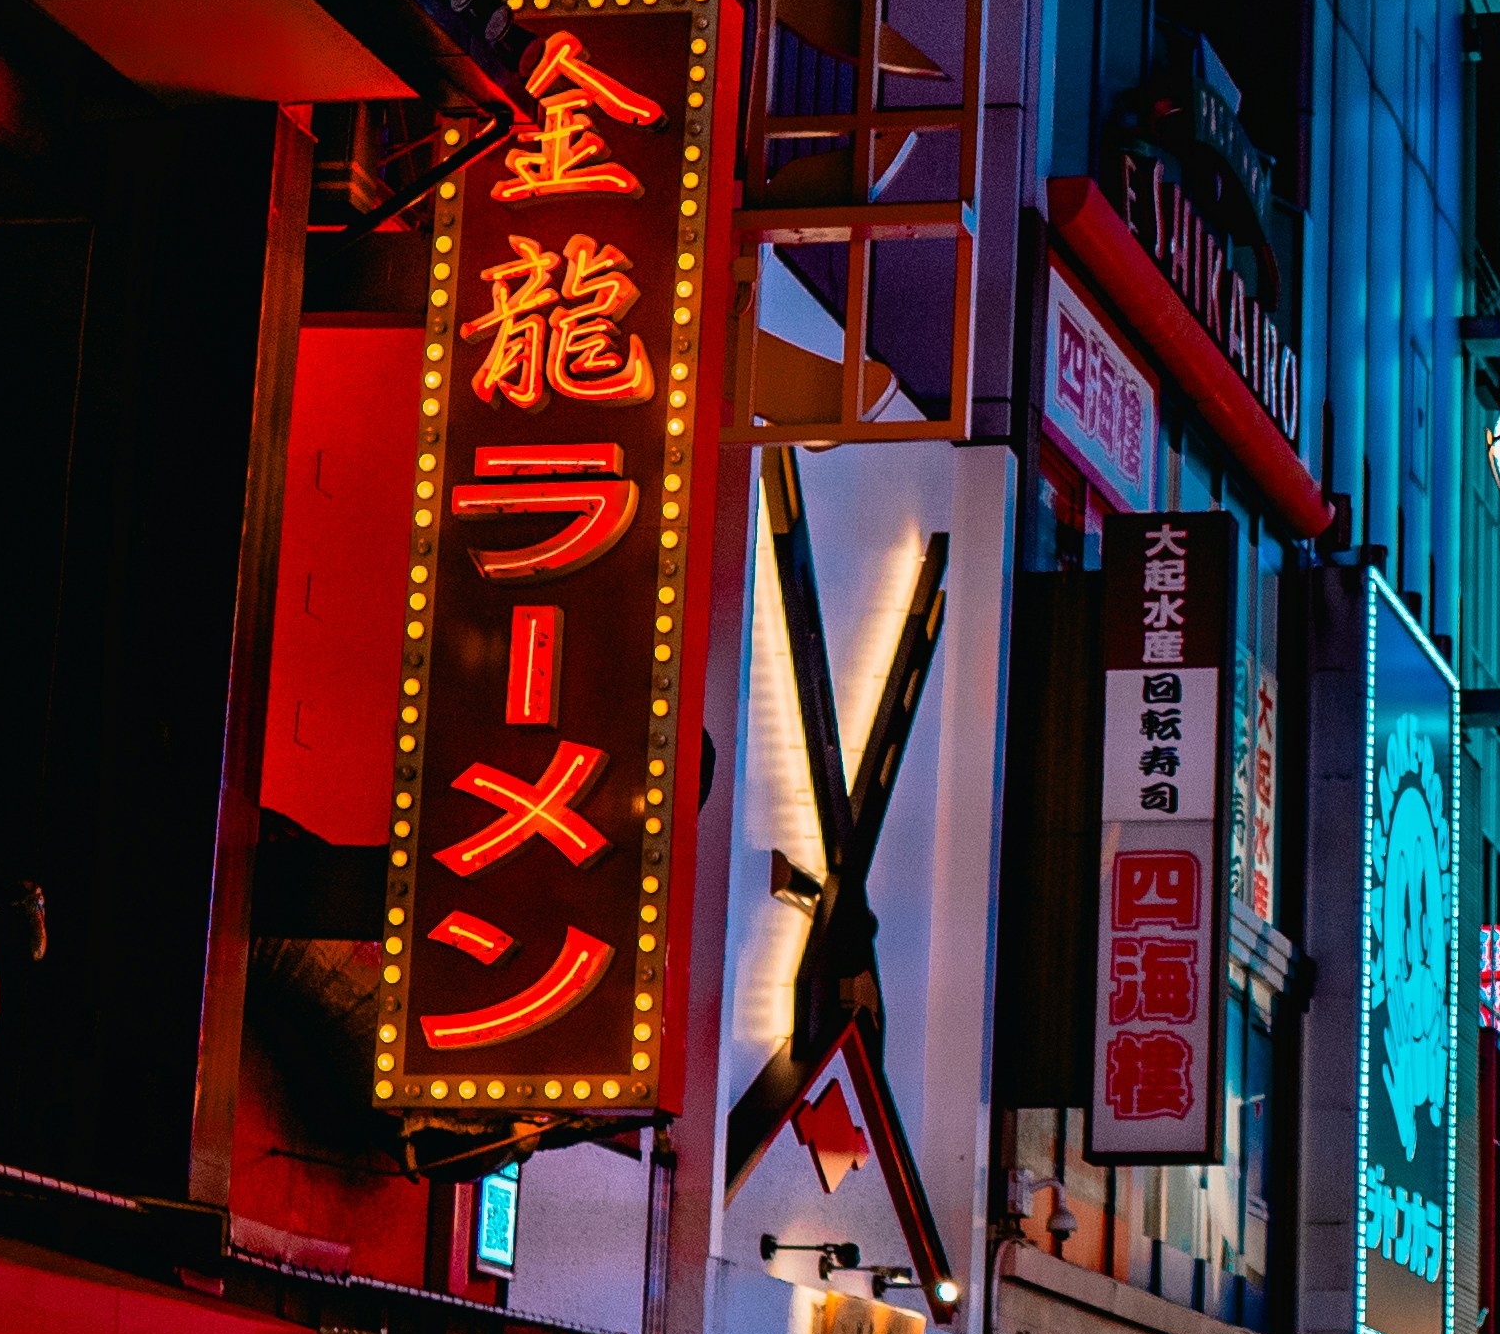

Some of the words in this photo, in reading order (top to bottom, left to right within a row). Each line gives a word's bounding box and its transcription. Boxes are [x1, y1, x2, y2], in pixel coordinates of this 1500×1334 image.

[420, 30, 668, 1051] 金龍ラーメン
[1141, 523, 1187, 665] 大起水産
[1139, 672, 1183, 815] 回転寿司
[1365, 1163, 1443, 1284] ジャンカラ
